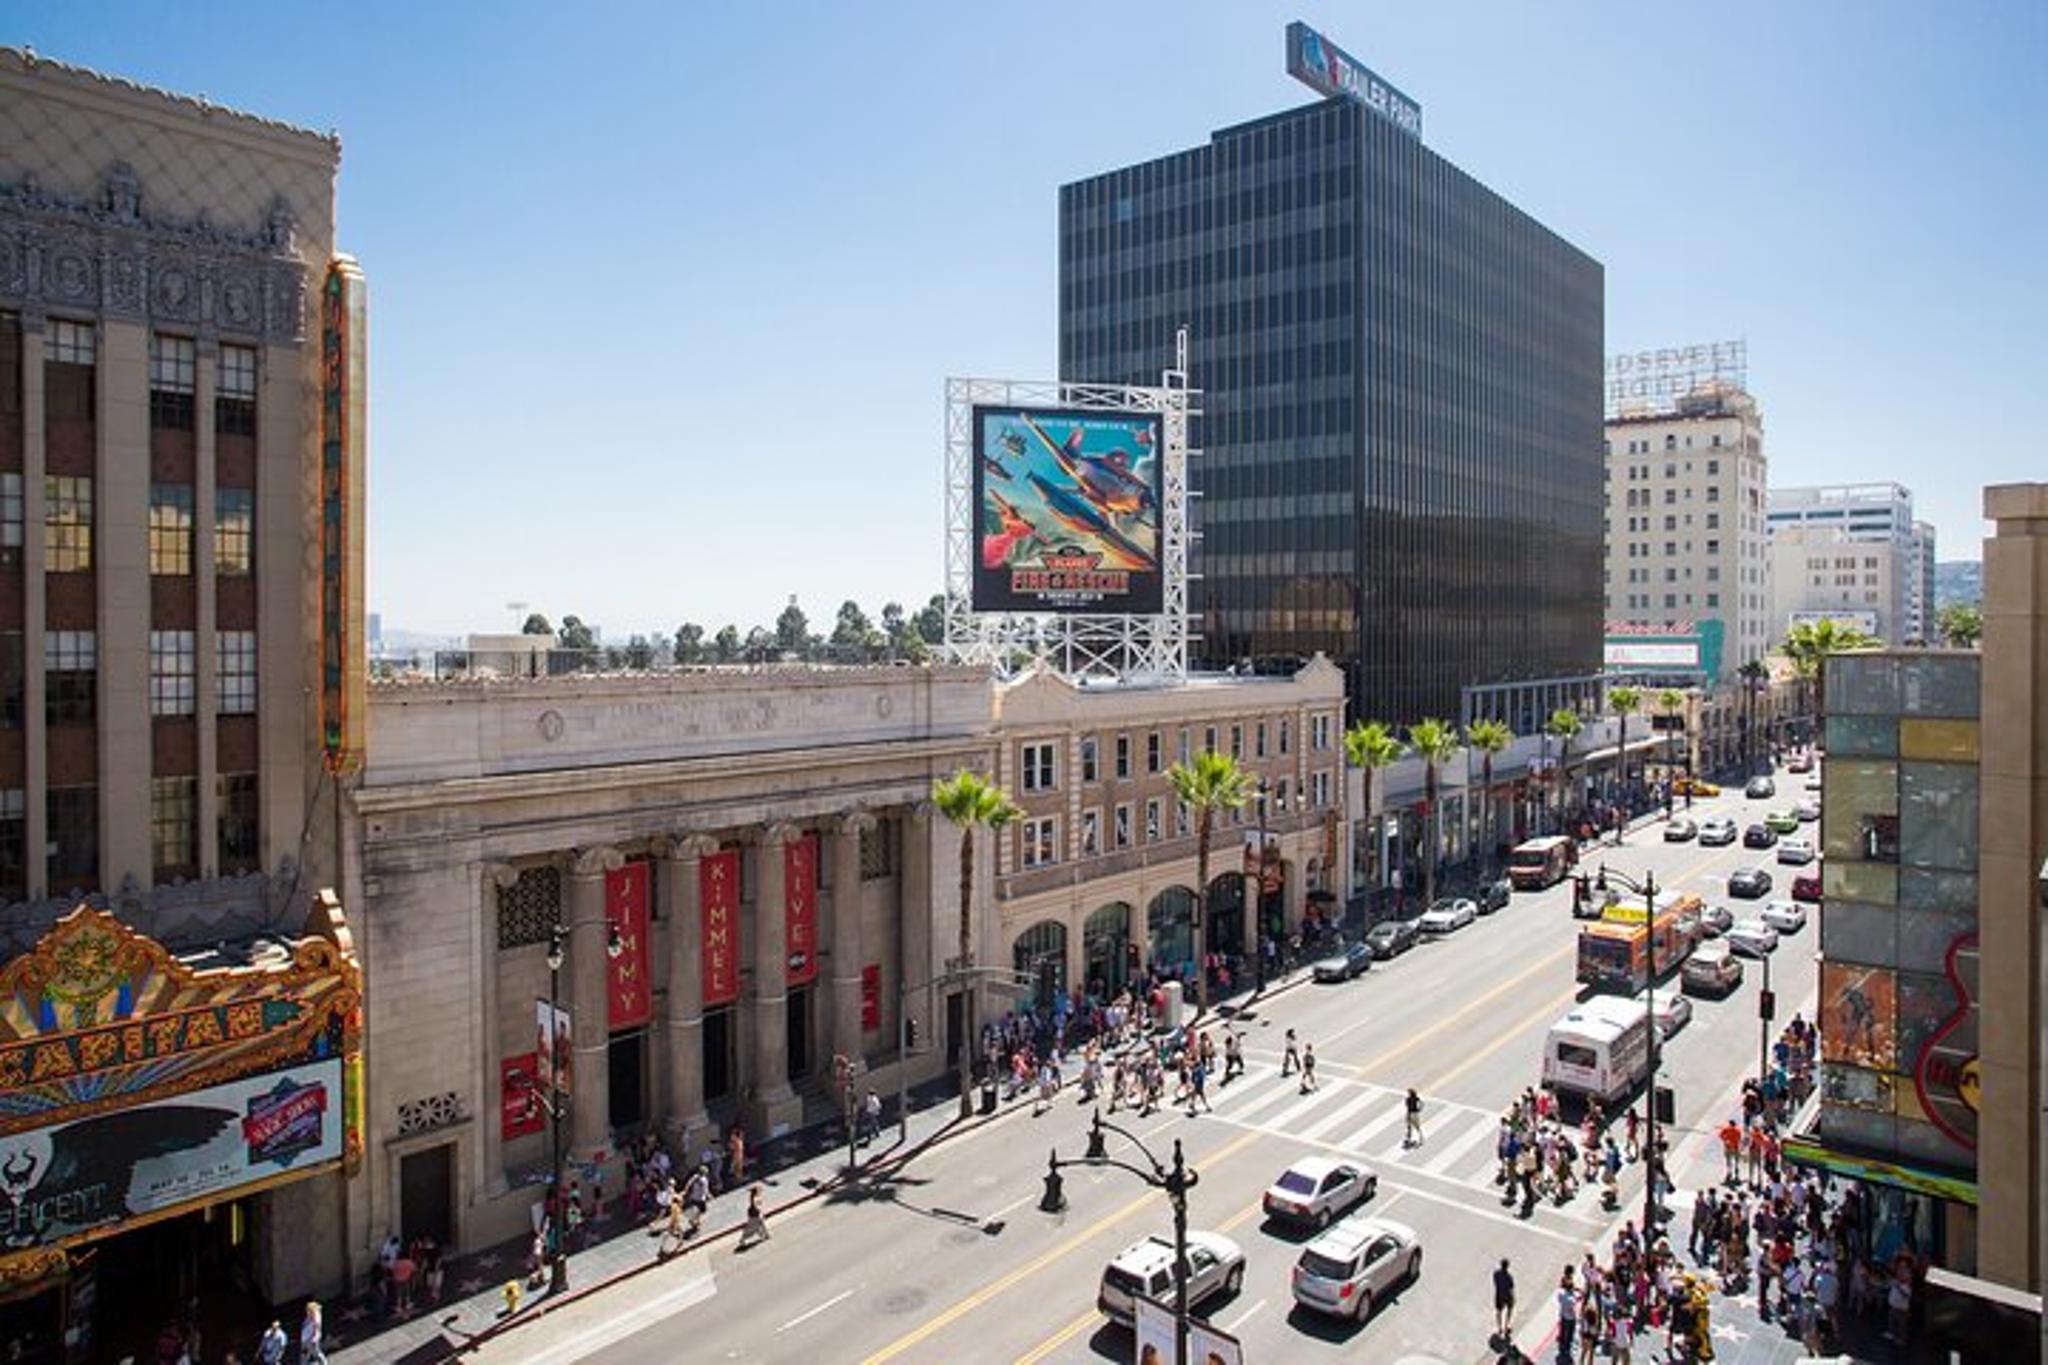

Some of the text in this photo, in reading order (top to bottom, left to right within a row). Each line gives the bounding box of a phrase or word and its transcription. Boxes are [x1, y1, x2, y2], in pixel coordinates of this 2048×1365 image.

[620, 877, 636, 1011] JIMMY
[709, 863, 727, 991] KIMMEL
[793, 850, 802, 942] LIVE
[0, 1004, 264, 1087] CAPITAN
